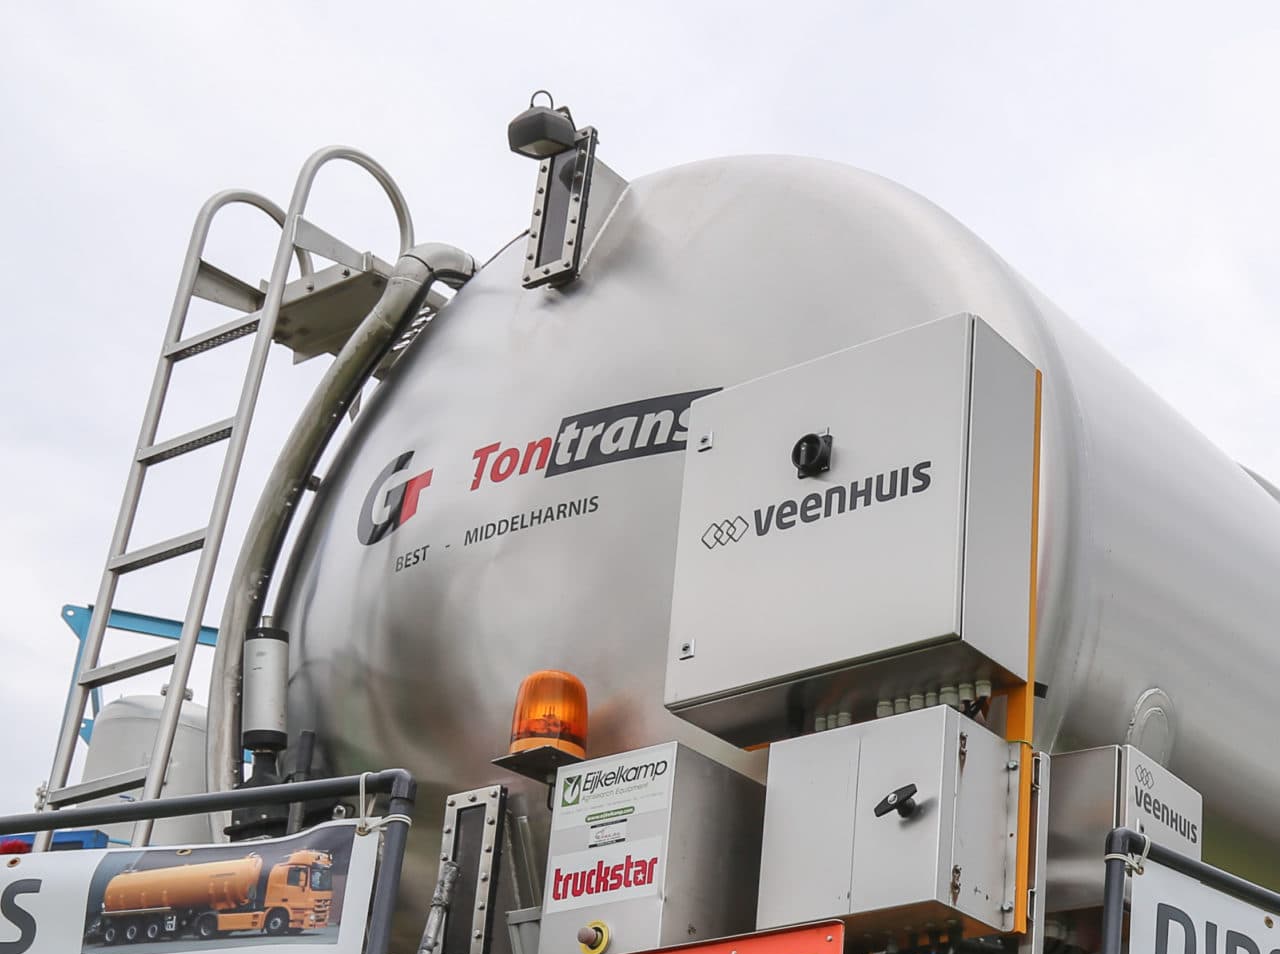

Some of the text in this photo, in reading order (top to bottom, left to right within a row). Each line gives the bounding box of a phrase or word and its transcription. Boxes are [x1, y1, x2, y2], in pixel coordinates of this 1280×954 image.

[395, 545, 430, 572] BEST
[463, 496, 600, 547] MIDDELHARNIS
[582, 760, 668, 794] Eijkelkamp
[552, 854, 658, 901] truckstar
